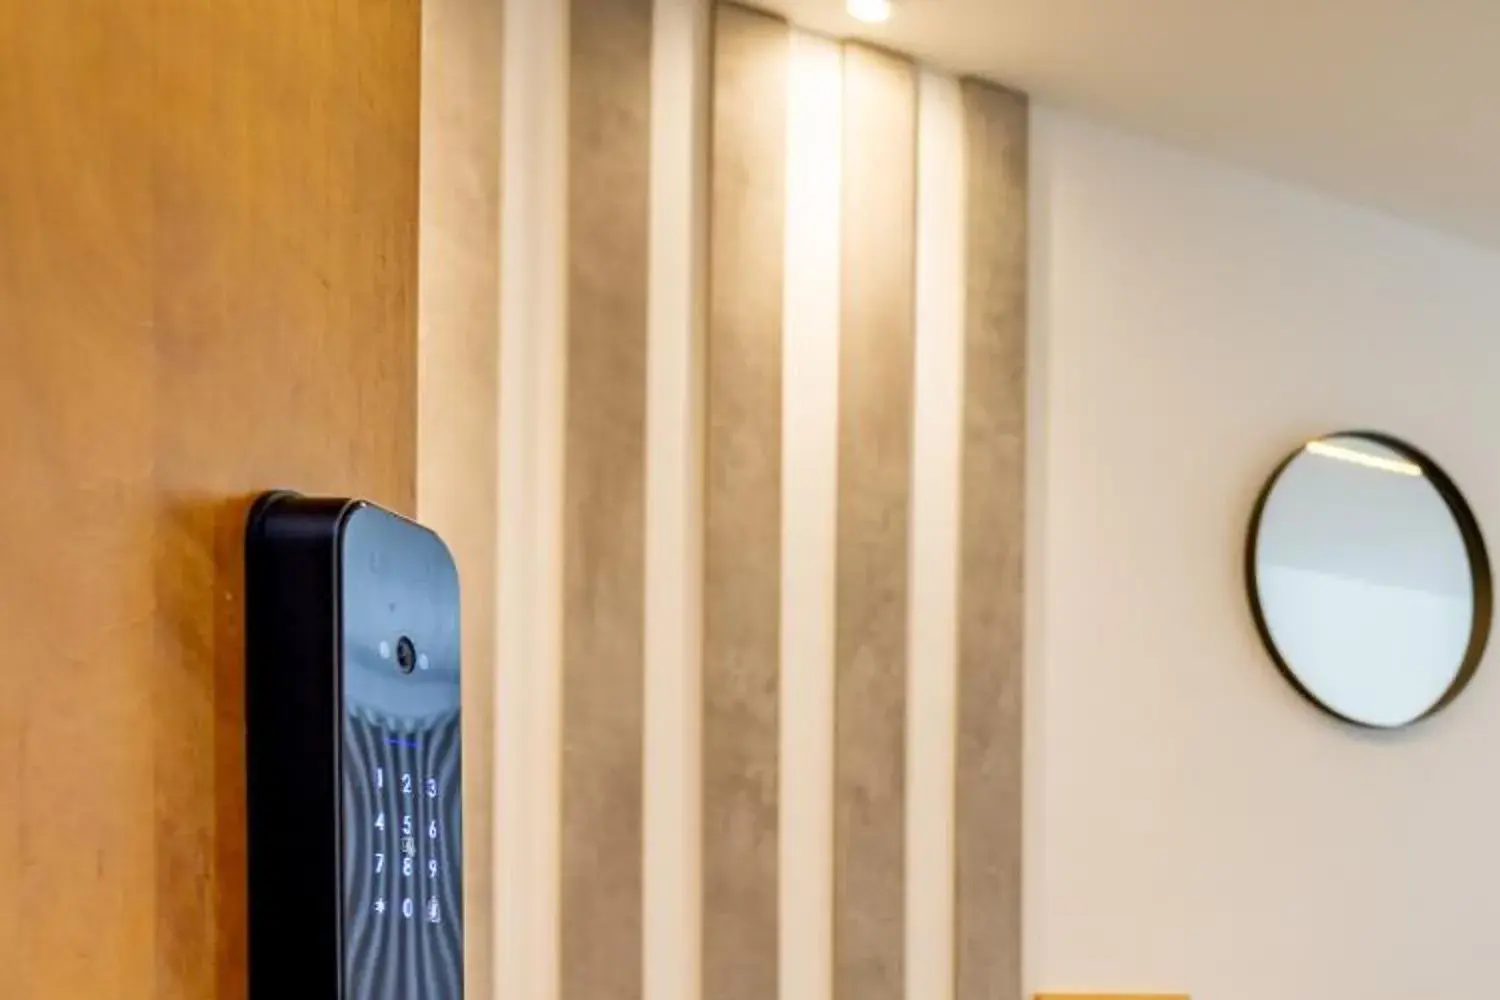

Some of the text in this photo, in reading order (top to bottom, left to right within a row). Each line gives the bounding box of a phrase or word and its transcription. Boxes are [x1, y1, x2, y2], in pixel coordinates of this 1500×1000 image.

[377, 768, 436, 798] 1 2 3
[375, 812, 437, 839] 4 5 6
[375, 853, 437, 878] 7 8 9
[402, 898, 413, 918] 0
